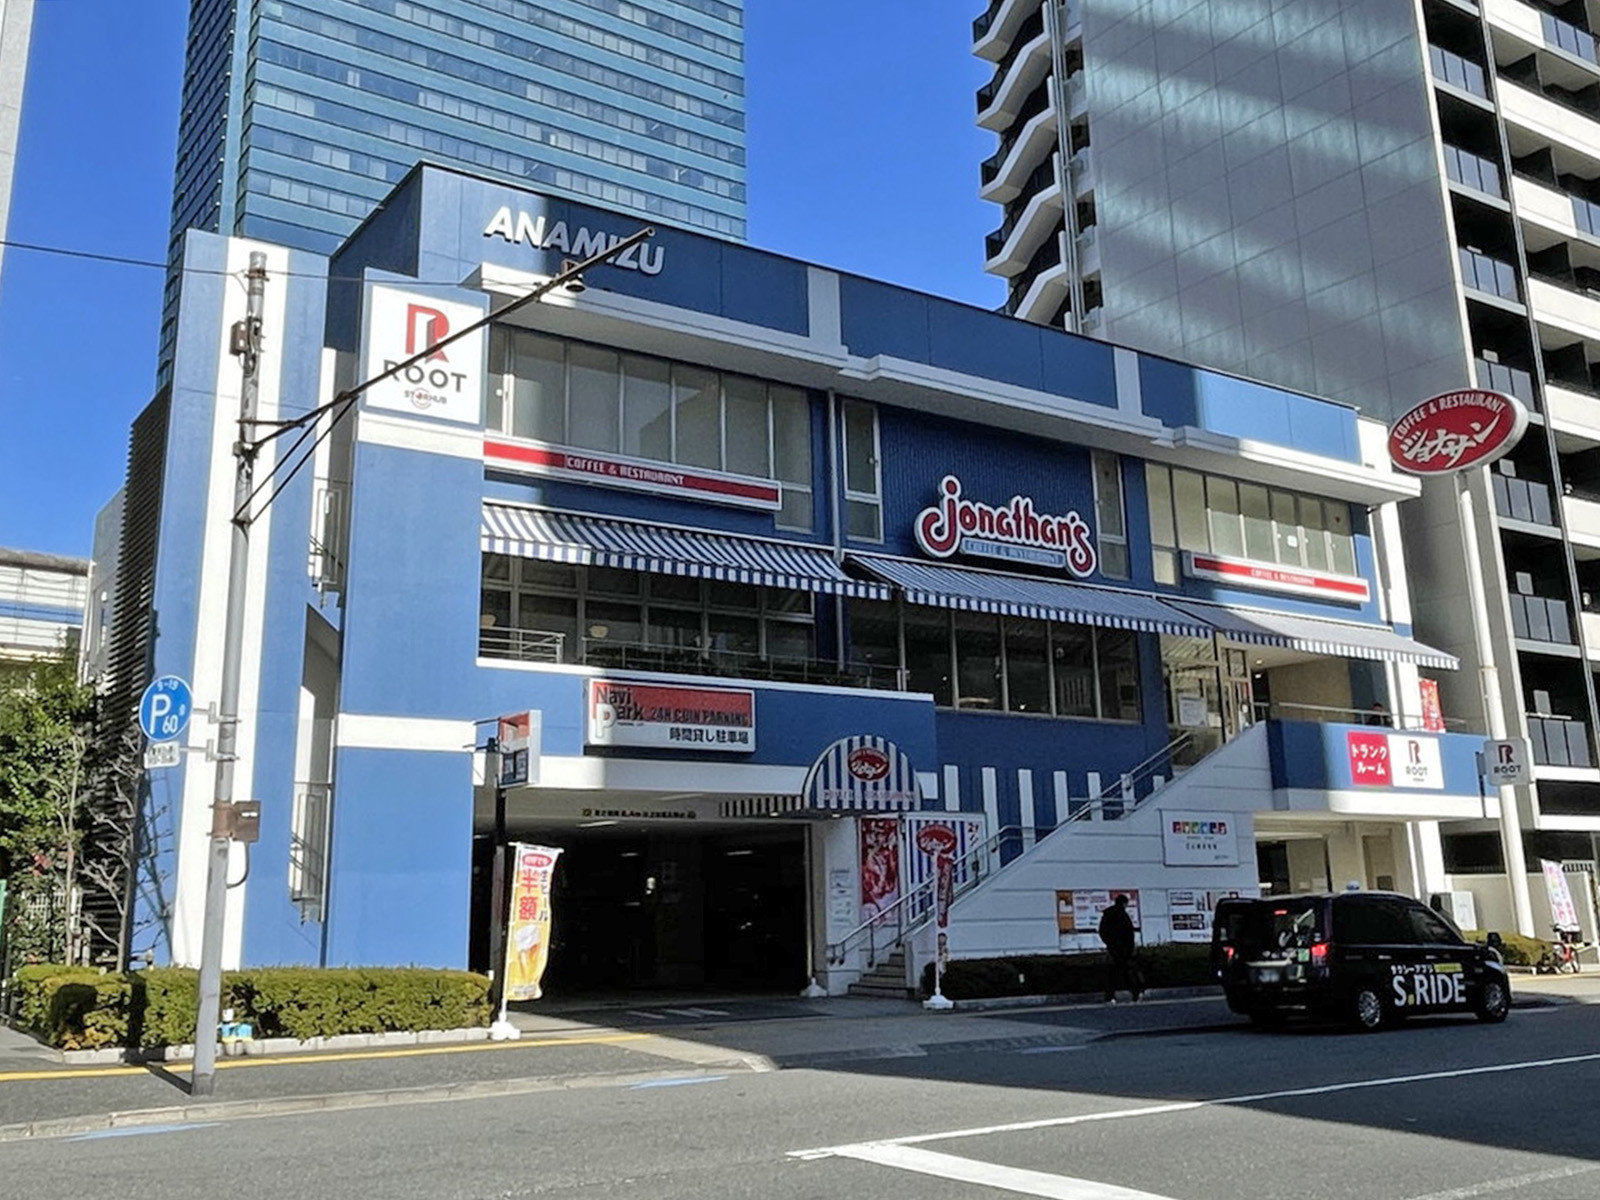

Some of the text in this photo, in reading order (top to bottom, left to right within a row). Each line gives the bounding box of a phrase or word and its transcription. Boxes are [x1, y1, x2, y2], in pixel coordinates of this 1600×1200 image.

[483, 206, 665, 275] ANAMIZU
[383, 359, 467, 393] ROOT
[1393, 407, 1428, 440] COFFEE
[1439, 392, 1506, 414] RESTAURANT
[567, 457, 605, 473] COFFEE
[619, 465, 685, 485] RESTAURANT
[595, 685, 632, 704] Navi
[150, 694, 171, 735] P
[162, 714, 178, 734] 60
[675, 708, 701, 724] COIN
[702, 709, 750, 727] PARKING
[669, 727, 749, 744] 時間貸し駐車場
[1351, 744, 1387, 760] トランク
[1357, 761, 1385, 775] ルーム
[1405, 766, 1428, 776] ROOT
[1493, 764, 1522, 774] ROOT
[519, 868, 539, 920] 半額
[1392, 972, 1467, 1007] S.RIDE
